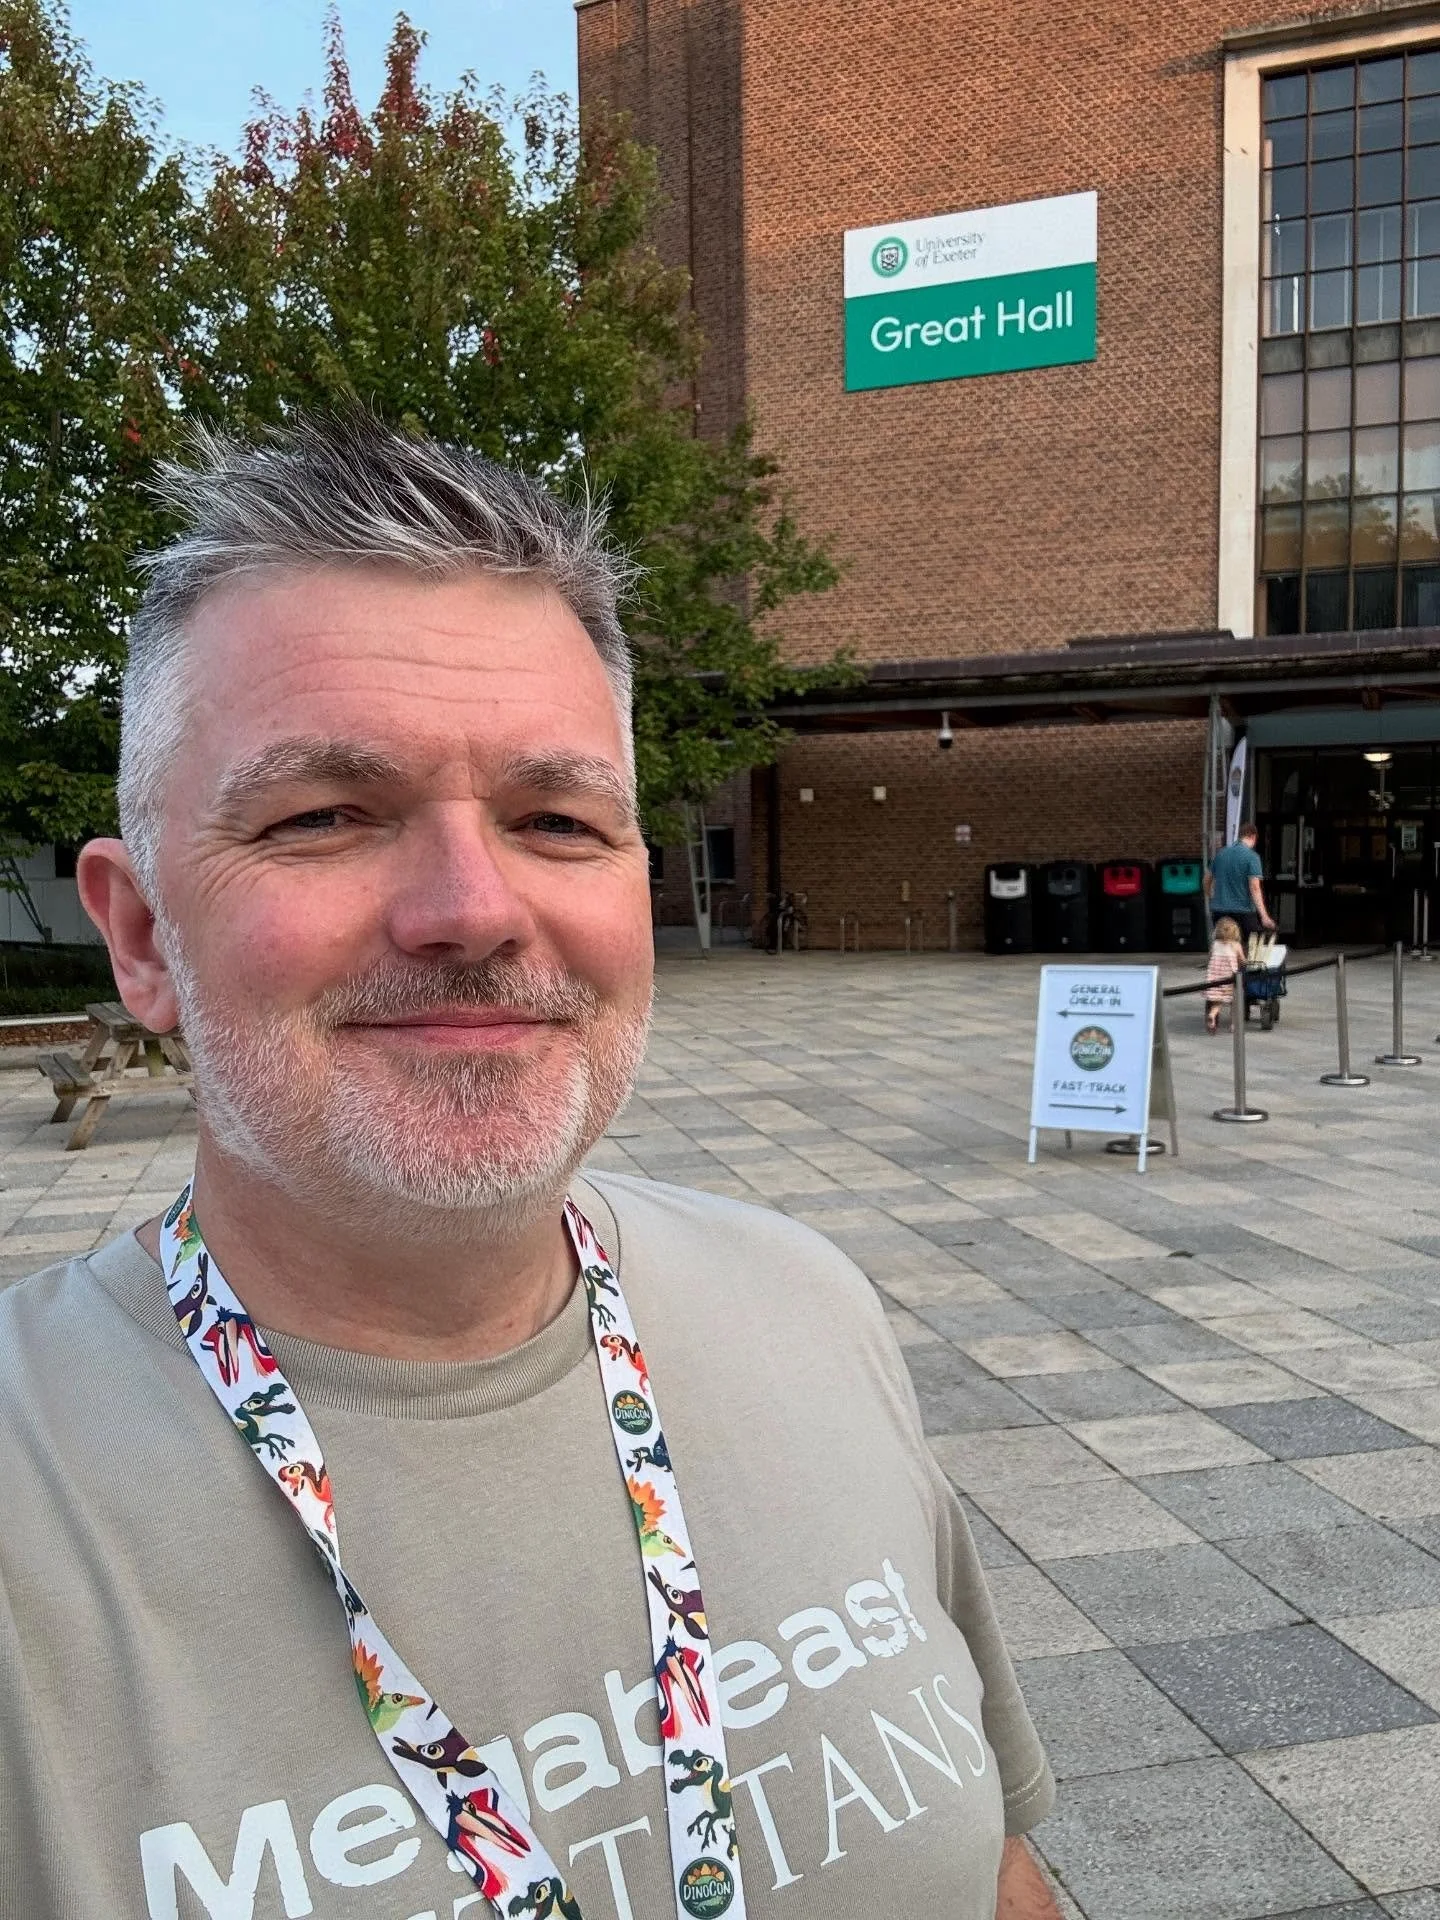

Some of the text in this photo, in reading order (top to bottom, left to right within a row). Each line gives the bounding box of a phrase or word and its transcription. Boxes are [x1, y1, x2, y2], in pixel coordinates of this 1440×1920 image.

[916, 232, 984, 252] University
[914, 248, 977, 268] of Exeter
[870, 290, 1073, 352] Great Hall
[1070, 984, 1121, 994] GENERAL
[568, 1674, 986, 1920] TTANS
